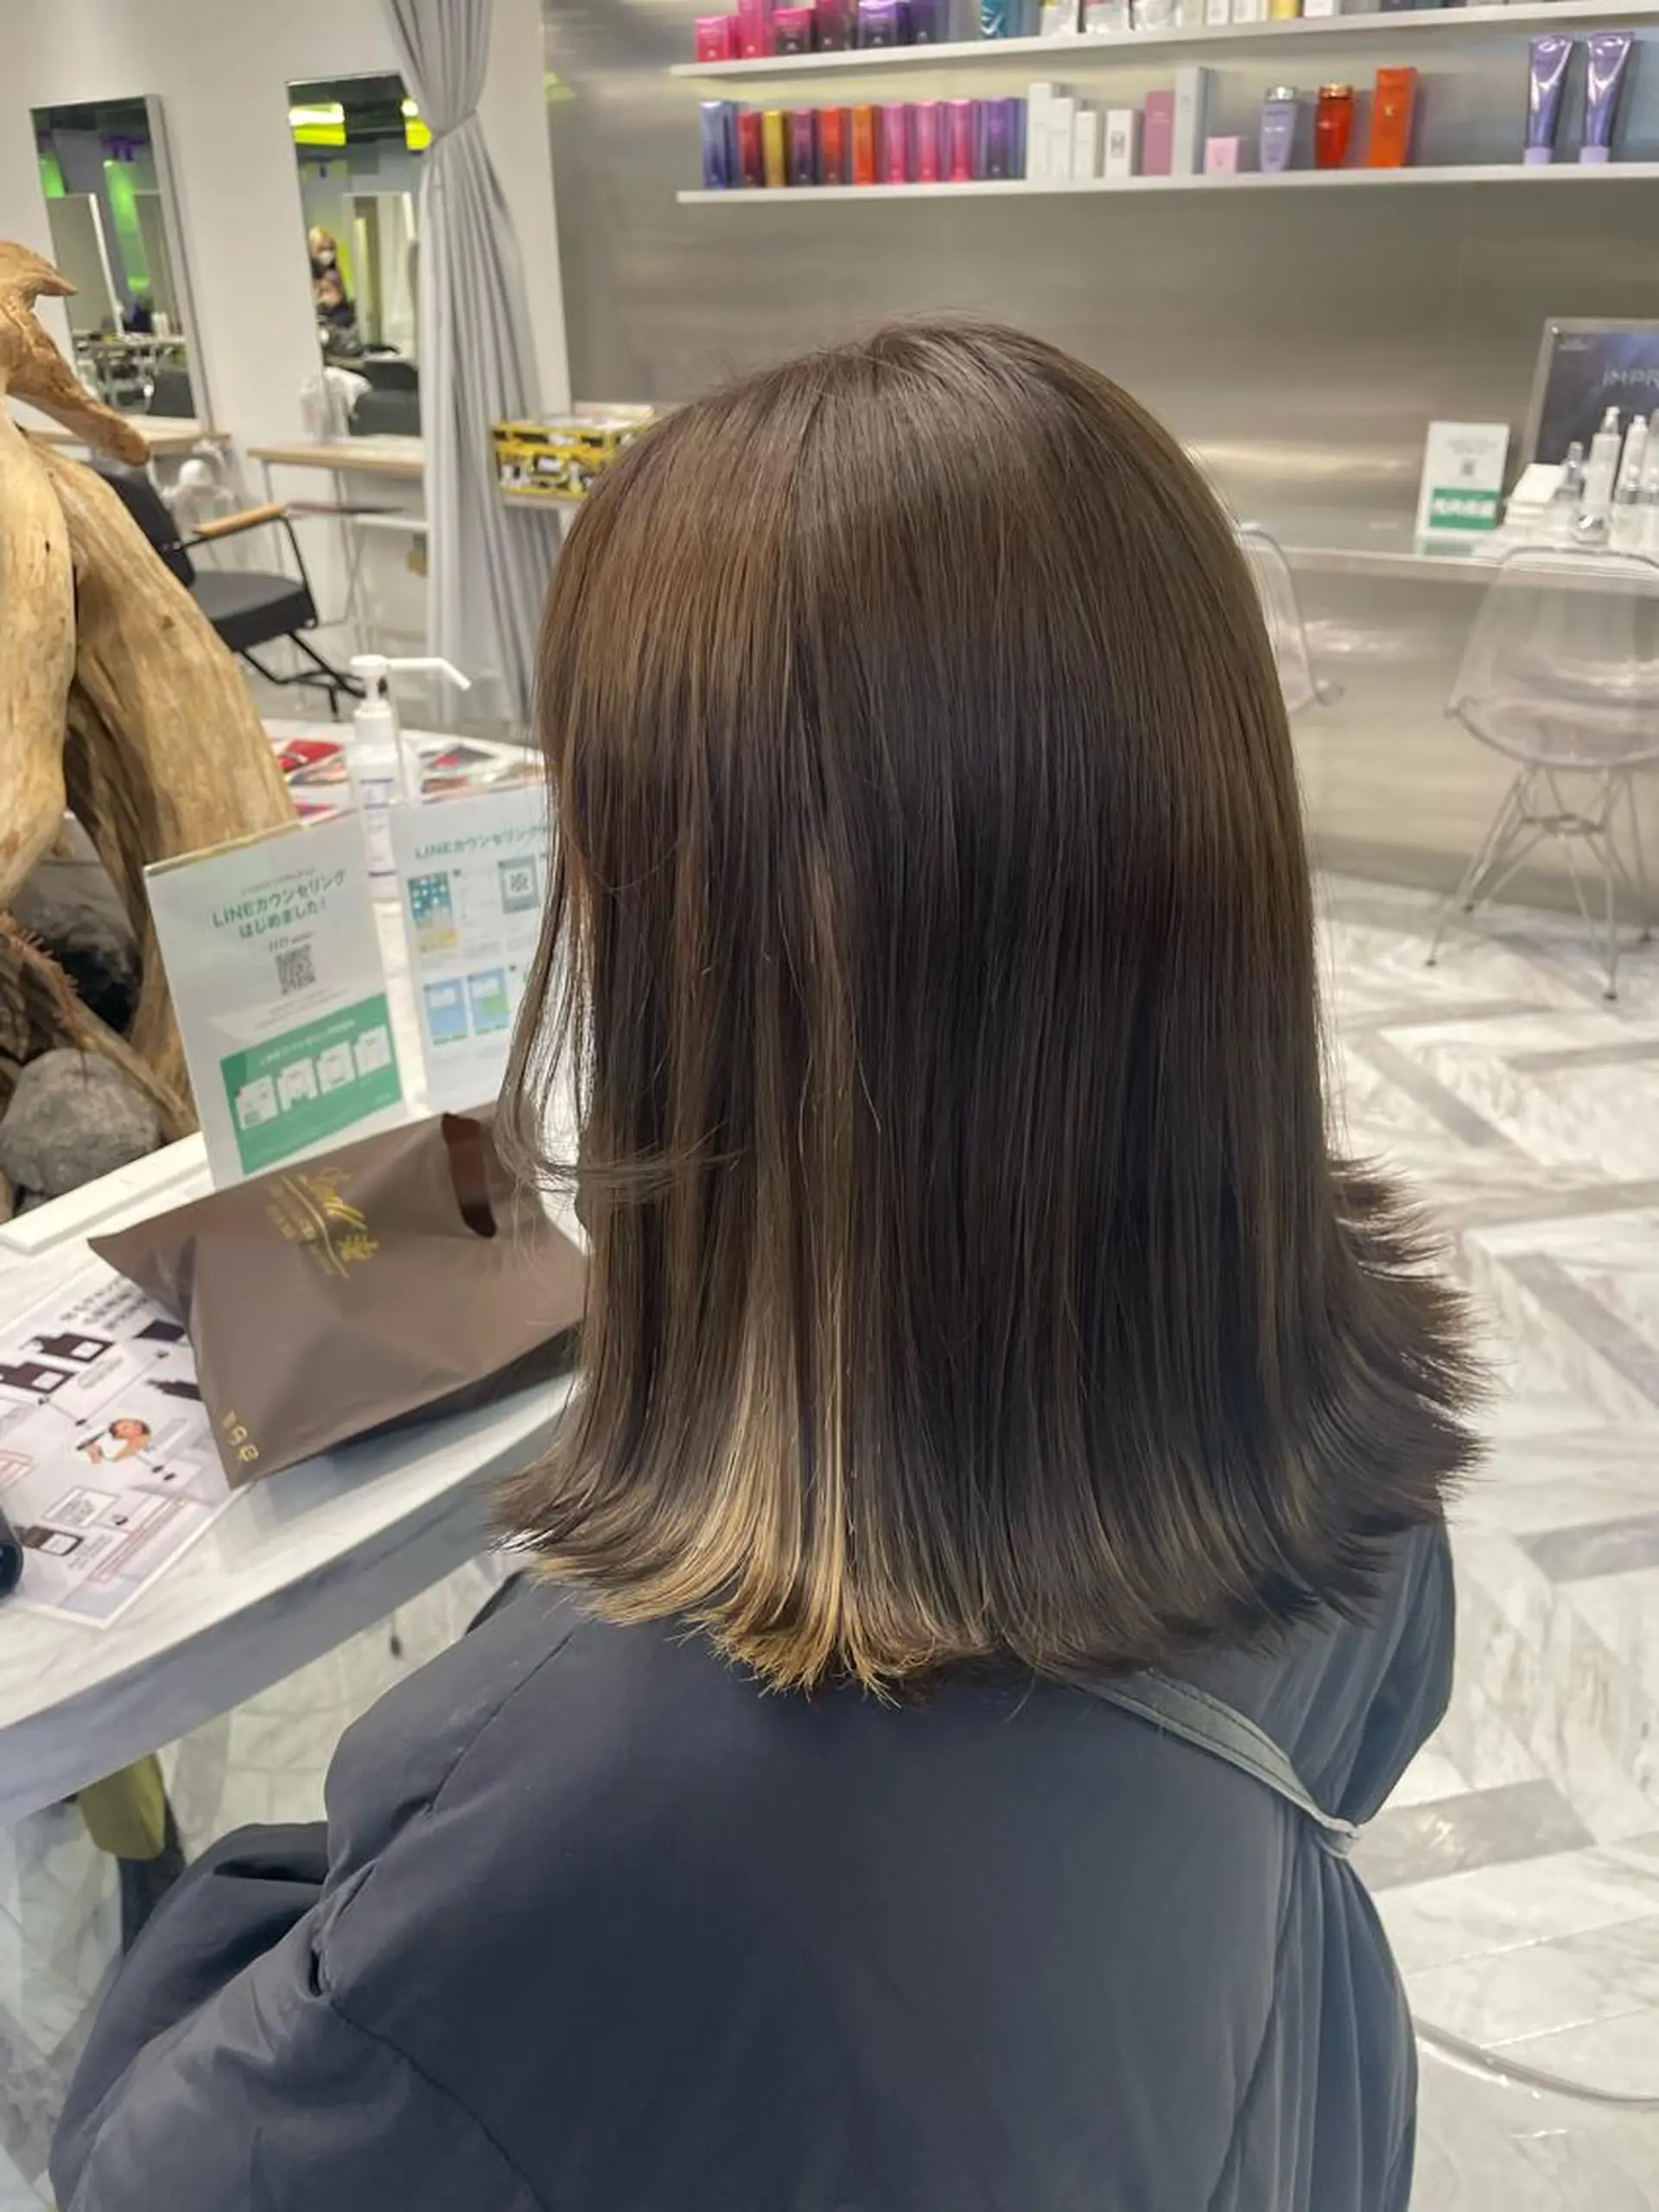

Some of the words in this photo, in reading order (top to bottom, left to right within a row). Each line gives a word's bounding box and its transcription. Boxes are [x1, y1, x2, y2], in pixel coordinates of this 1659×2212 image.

[212, 868, 346, 928] LINEカウンセリング
